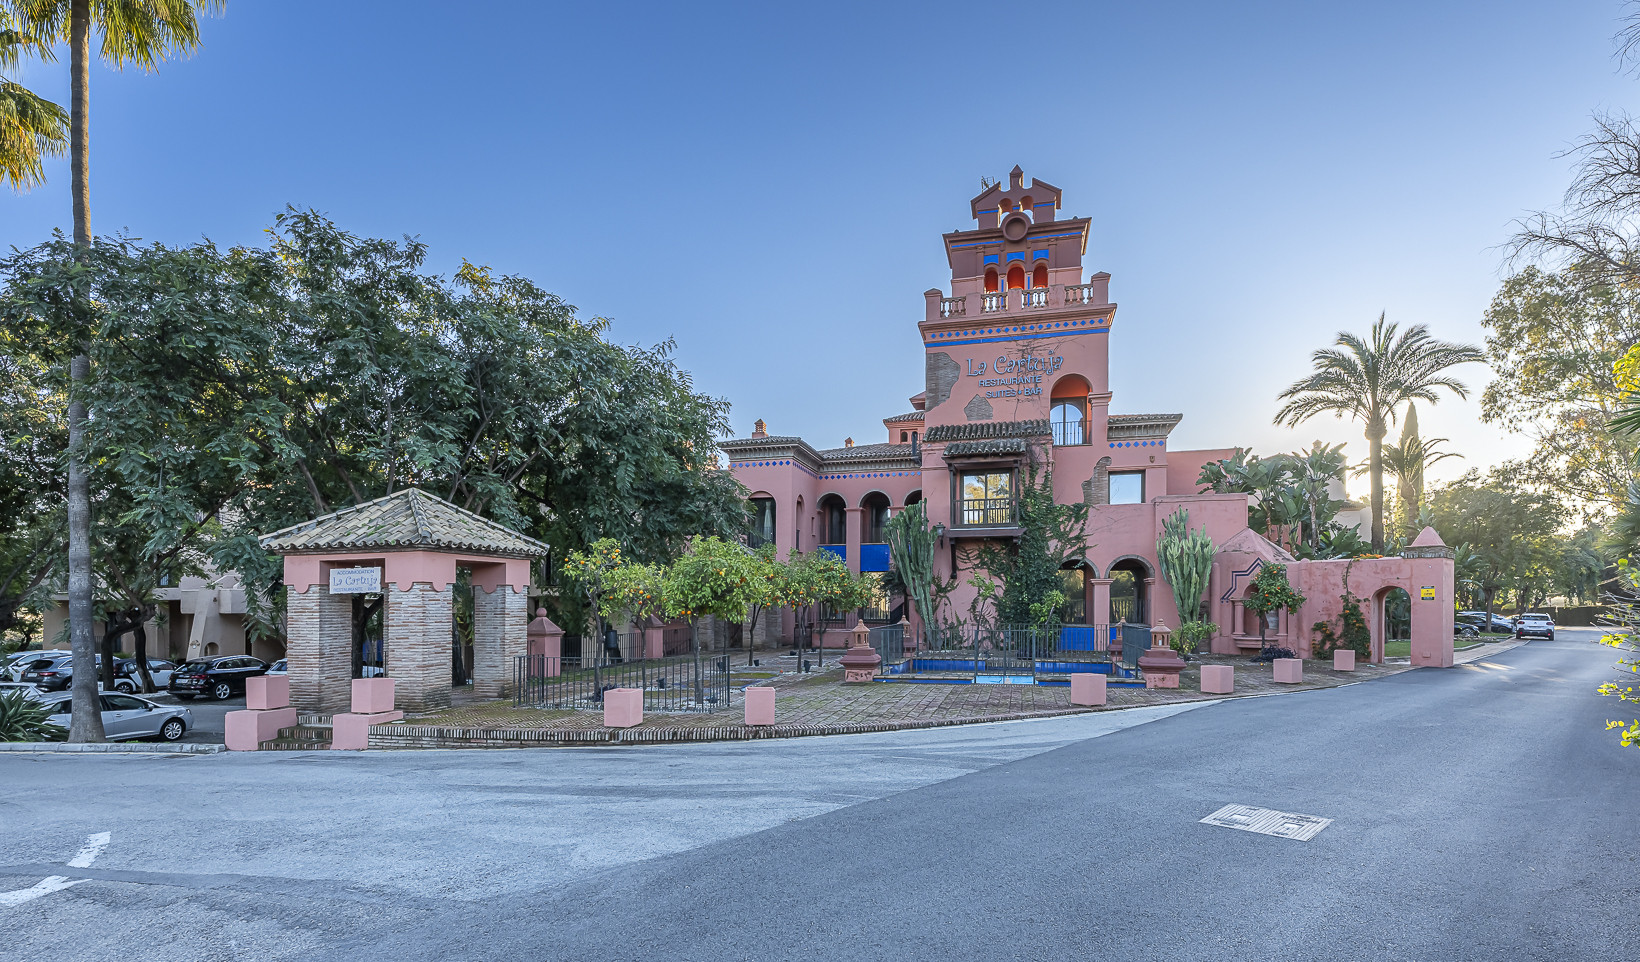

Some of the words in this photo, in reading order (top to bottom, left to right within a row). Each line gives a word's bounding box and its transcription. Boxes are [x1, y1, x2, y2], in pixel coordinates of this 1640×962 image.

[966, 358, 987, 376] La
[993, 350, 1064, 375] Cartuja
[978, 375, 1042, 387] RESTAURANTE
[985, 389, 1017, 399] SUITES
[1024, 387, 1043, 396] BAR
[333, 576, 343, 586] La
[345, 574, 378, 587] Cartuja
